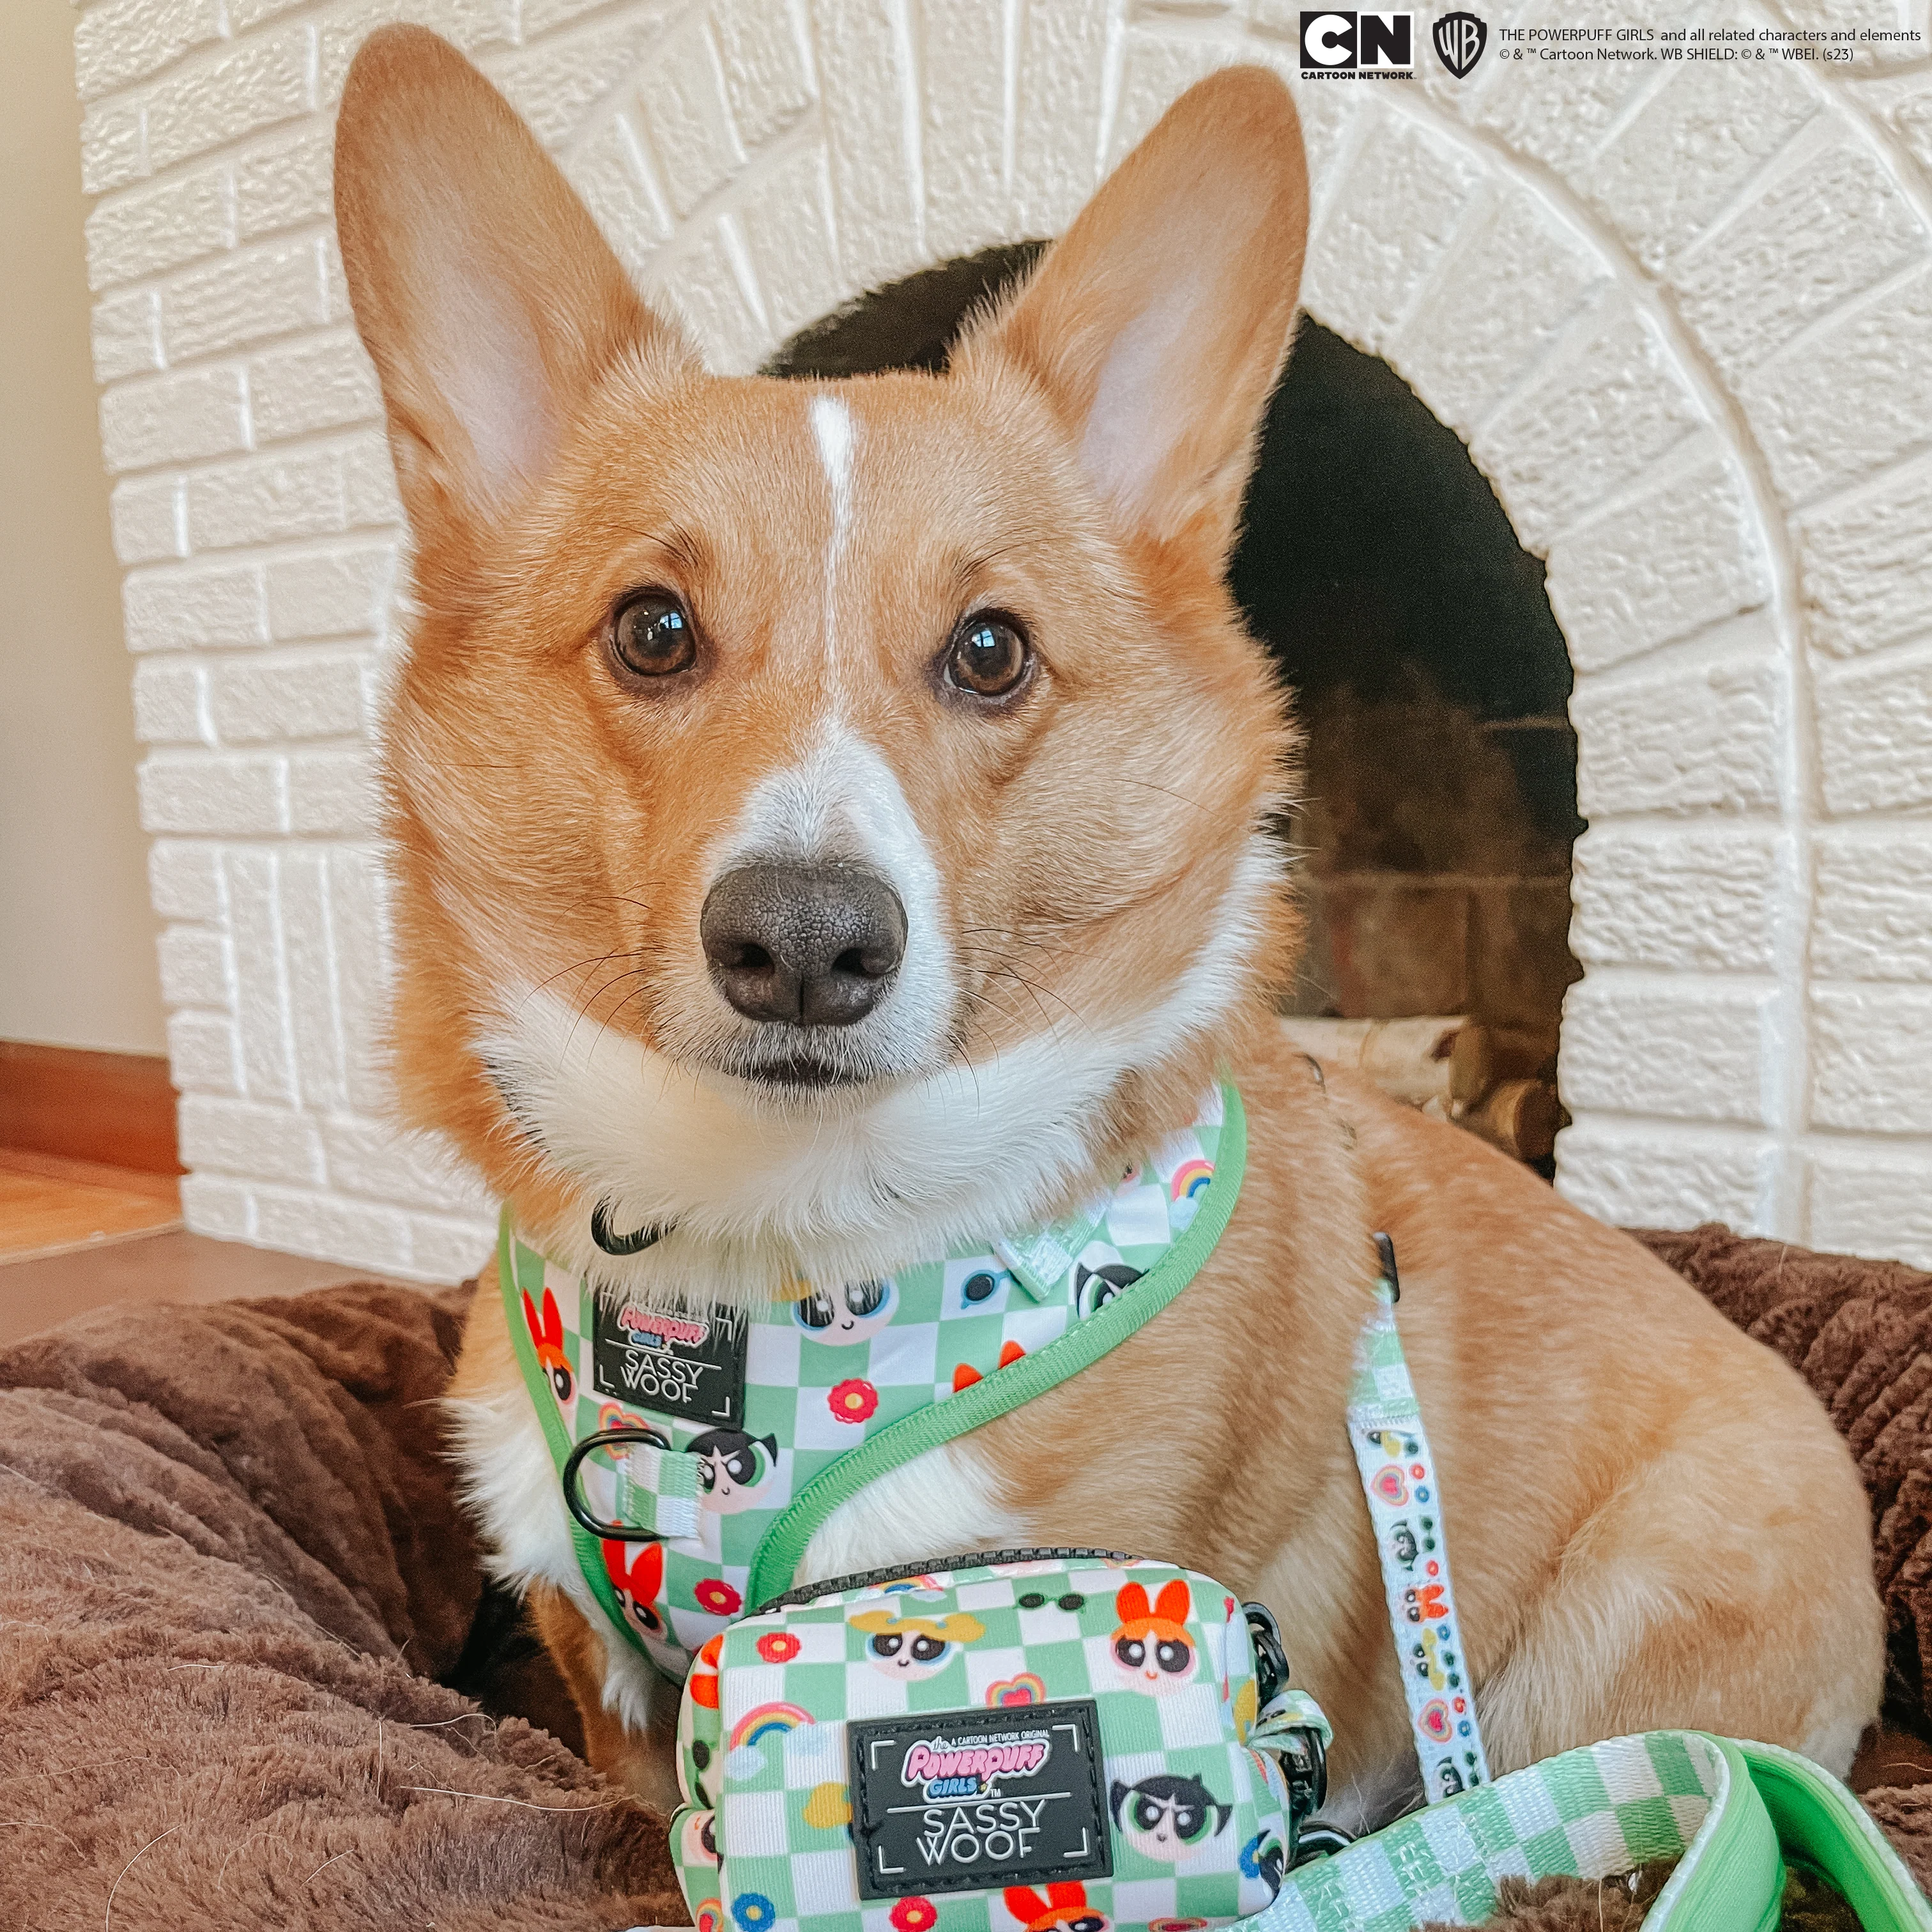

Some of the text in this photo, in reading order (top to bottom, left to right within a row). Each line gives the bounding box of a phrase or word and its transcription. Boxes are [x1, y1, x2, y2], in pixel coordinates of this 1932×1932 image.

[620, 1366, 698, 1403] WOOF
[625, 1349, 703, 1386] SASSY
[933, 1738, 949, 1751] the
[951, 1729, 1050, 1746] A CARTOON NETWORK ORIGINAL
[906, 1743, 1046, 1782] POWERPUFF
[928, 1777, 977, 1797] GIRLS
[923, 1799, 1046, 1837] SASSY
[916, 1827, 1041, 1866] WOOF
